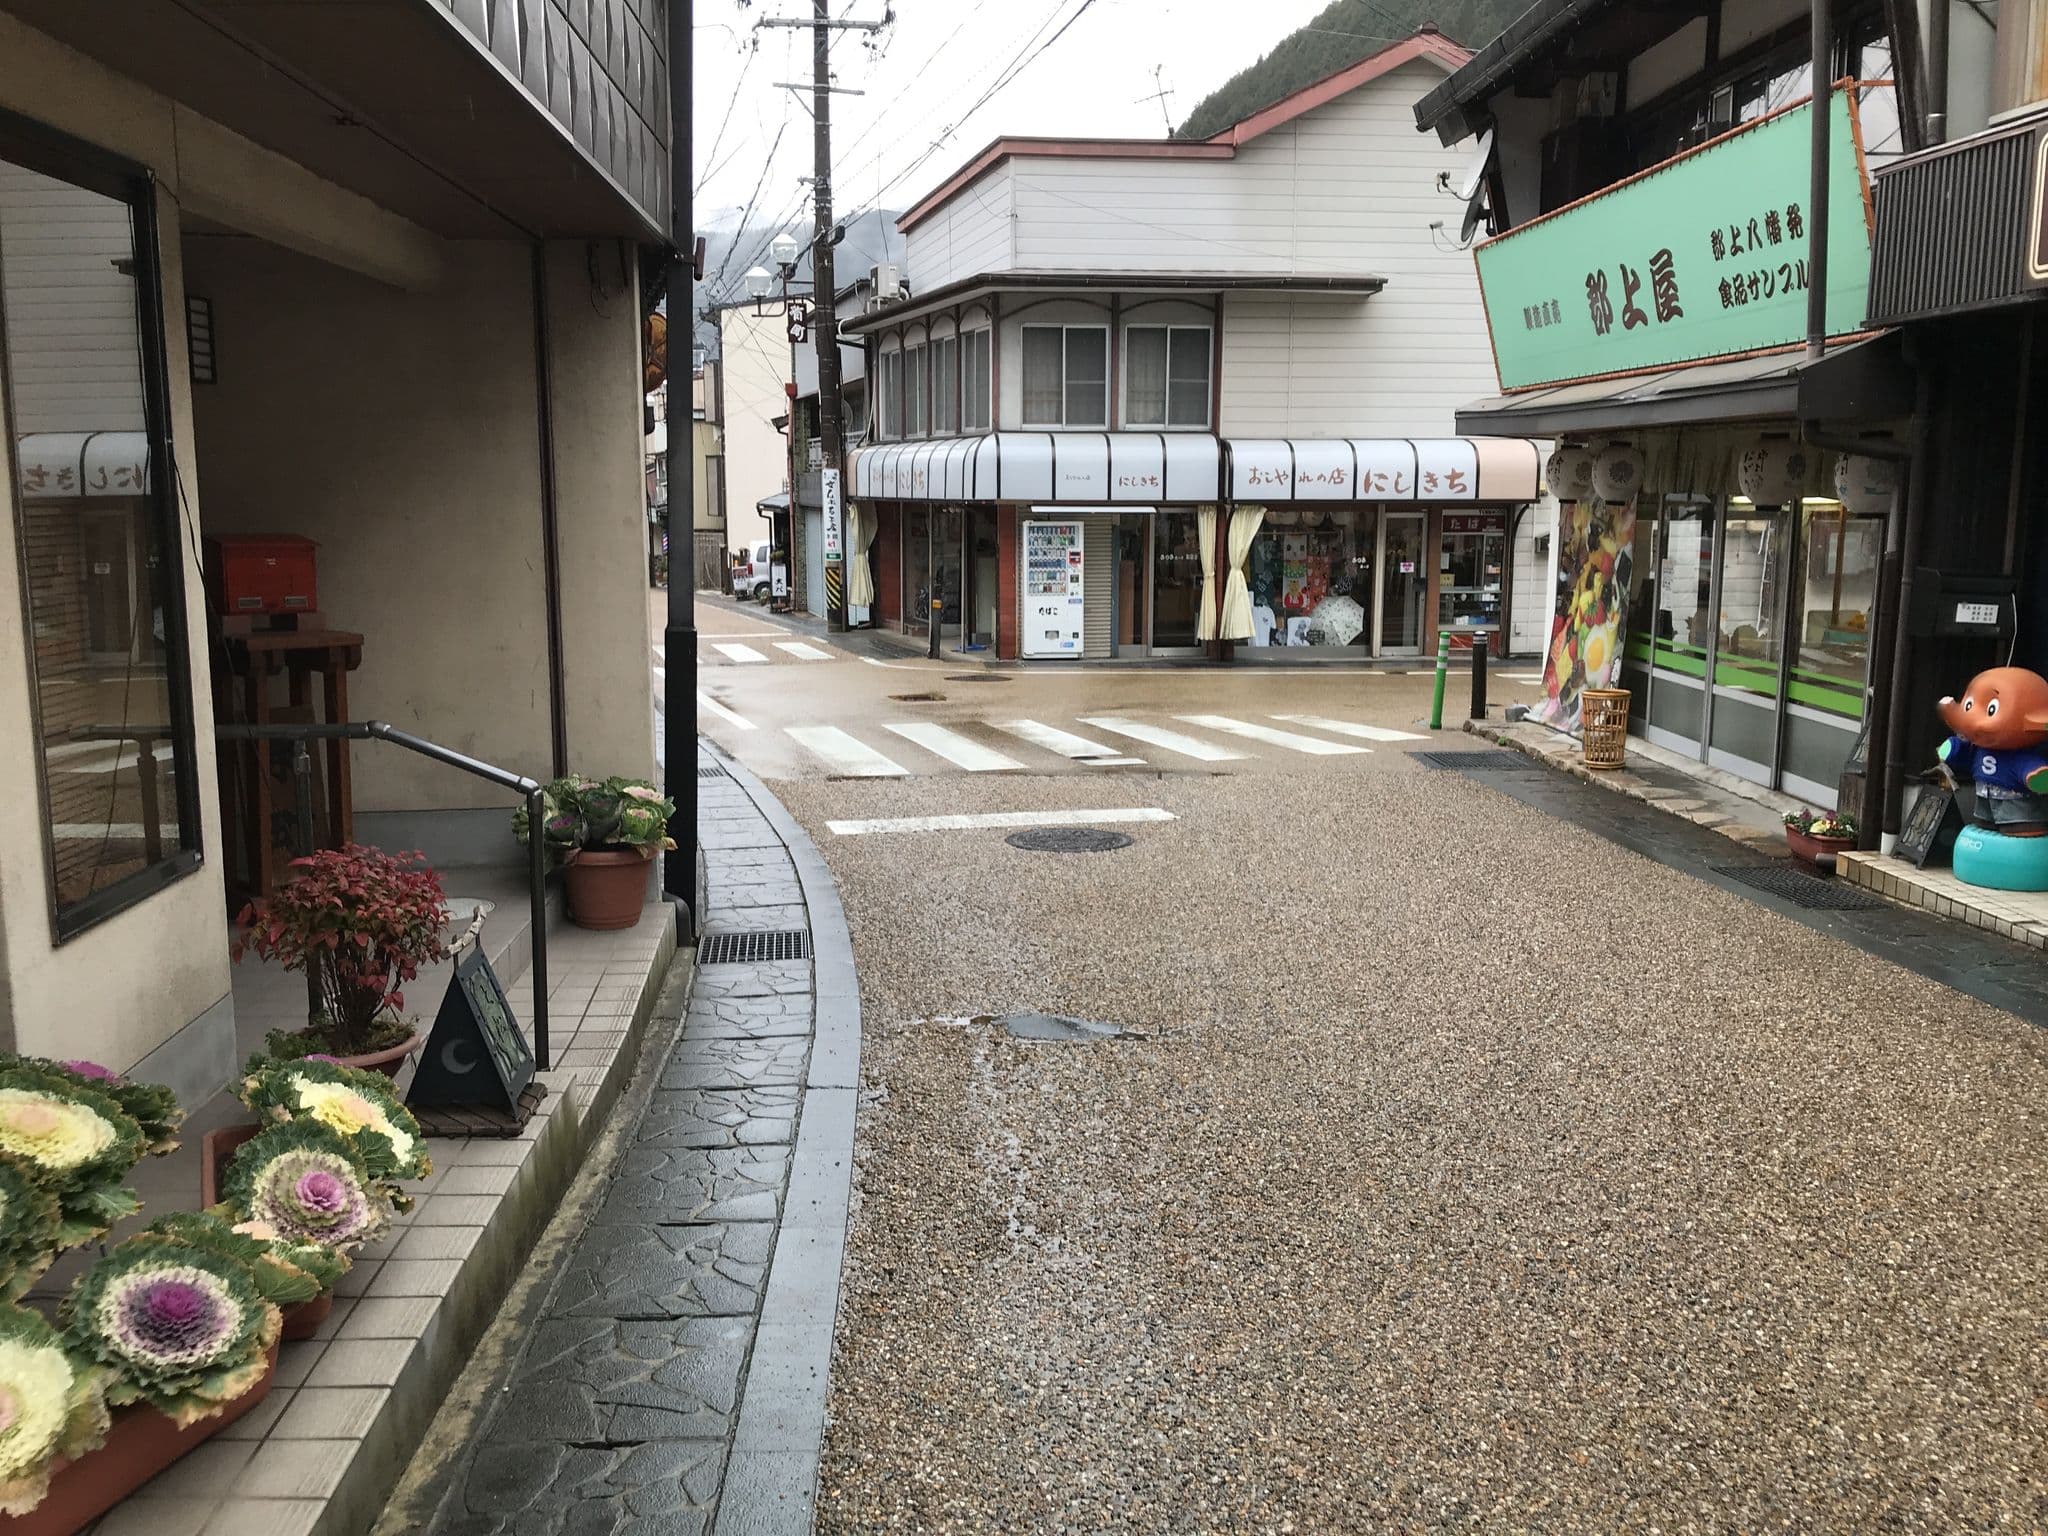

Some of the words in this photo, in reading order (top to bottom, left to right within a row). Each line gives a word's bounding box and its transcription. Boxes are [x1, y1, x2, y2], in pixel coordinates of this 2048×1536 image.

[1585, 248, 1683, 336] 郡上屋
[1118, 474, 1159, 487] にしきち
[1363, 467, 1467, 494] にしきち
[1981, 755, 1998, 775] S
